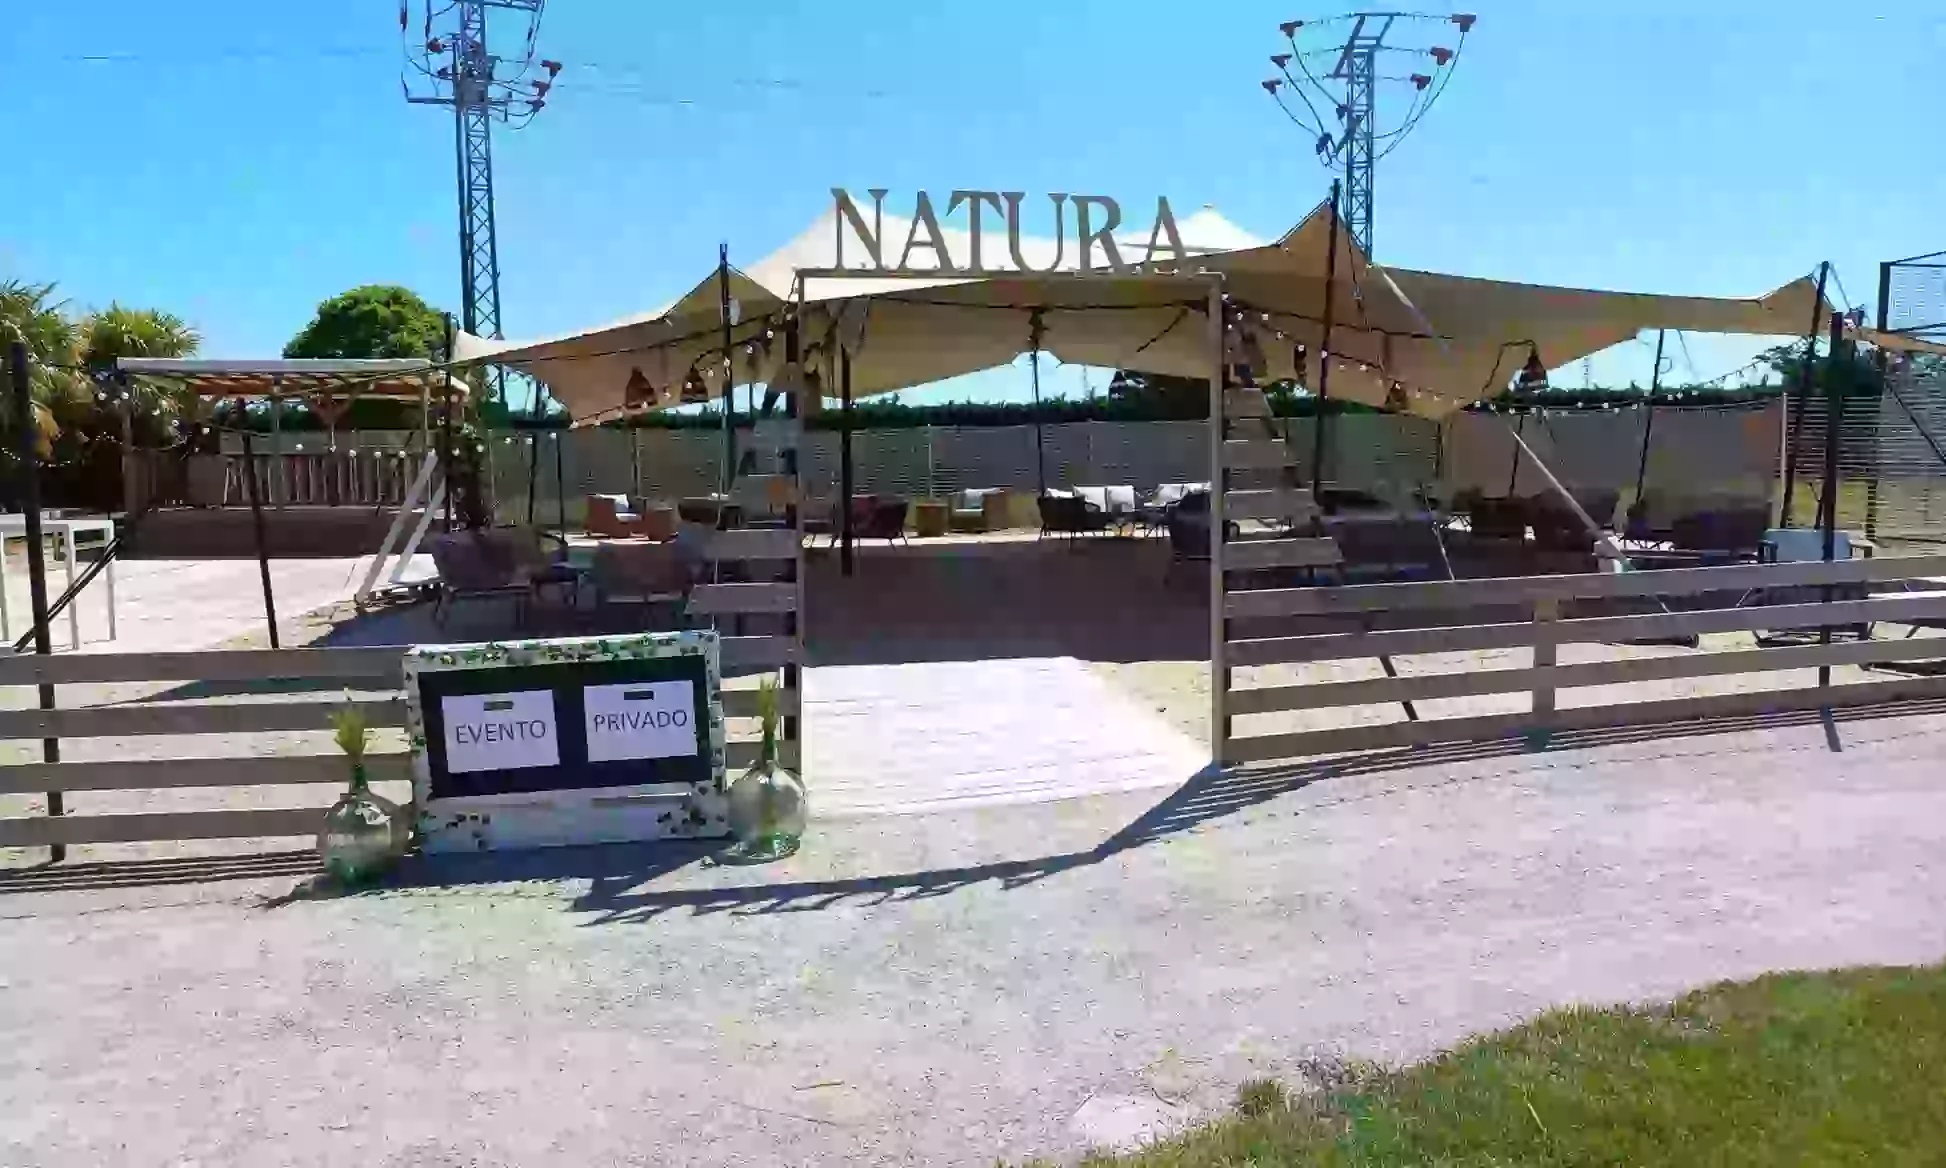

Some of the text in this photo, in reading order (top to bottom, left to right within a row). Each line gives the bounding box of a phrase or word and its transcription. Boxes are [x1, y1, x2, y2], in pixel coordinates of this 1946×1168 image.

[830, 187, 1192, 275] NATURA
[455, 709, 688, 745] EVENTO PRIVADO
